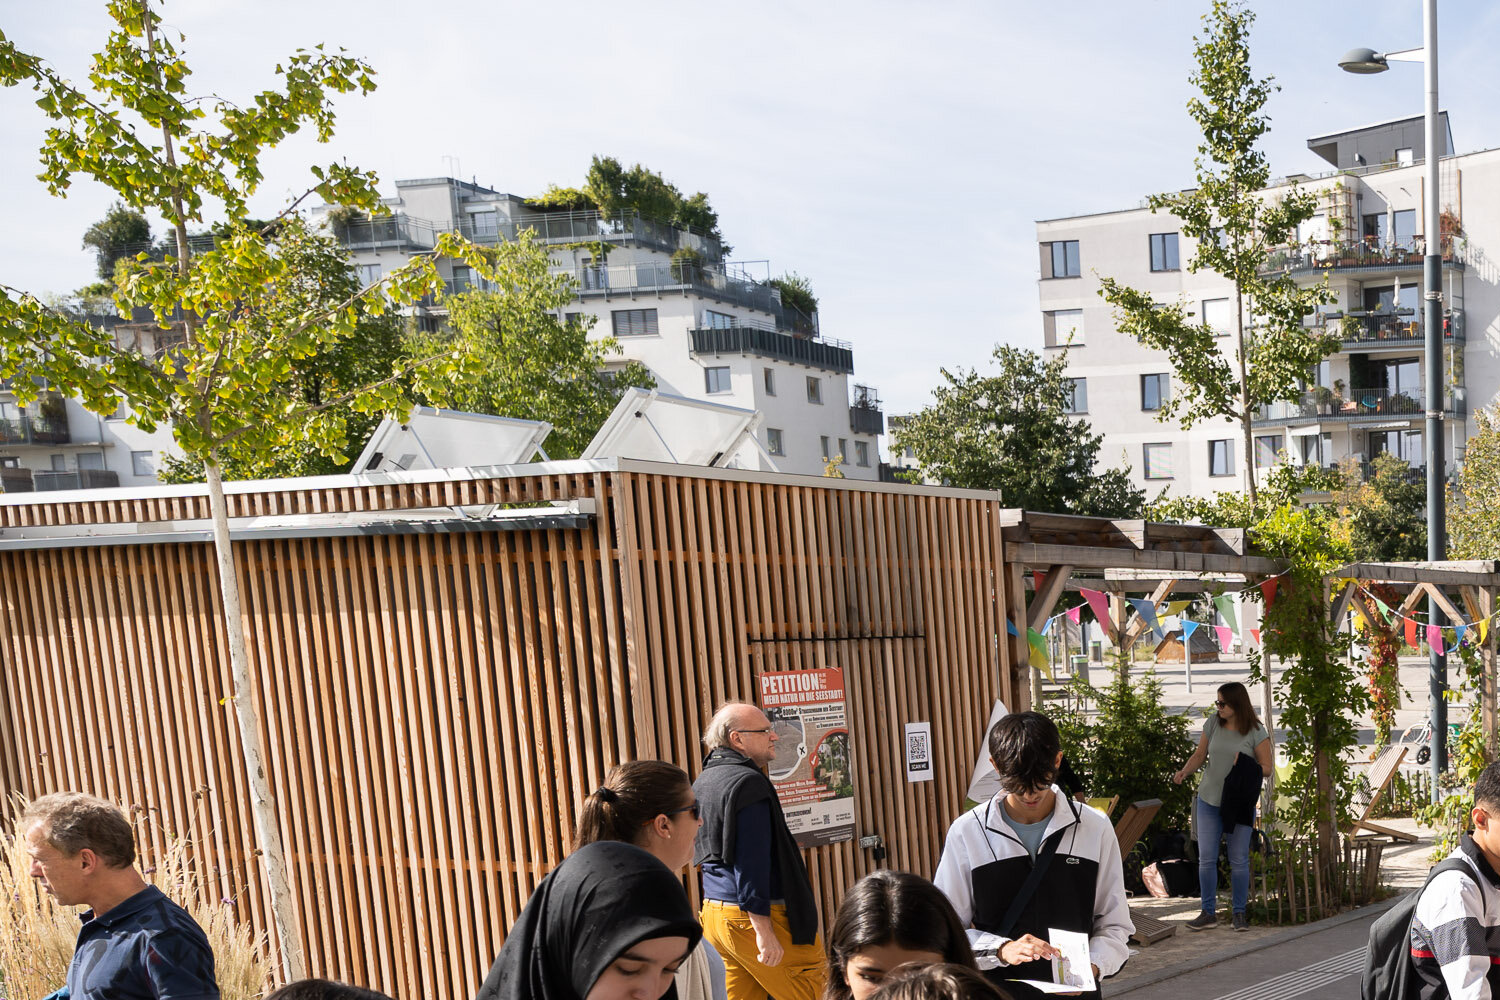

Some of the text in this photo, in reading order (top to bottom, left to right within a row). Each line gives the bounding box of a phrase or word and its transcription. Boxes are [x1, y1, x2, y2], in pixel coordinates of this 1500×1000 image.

[762, 673, 819, 694] PETITION
[764, 690, 844, 705] MEHR NATUR IN DIE SEESTADT!
